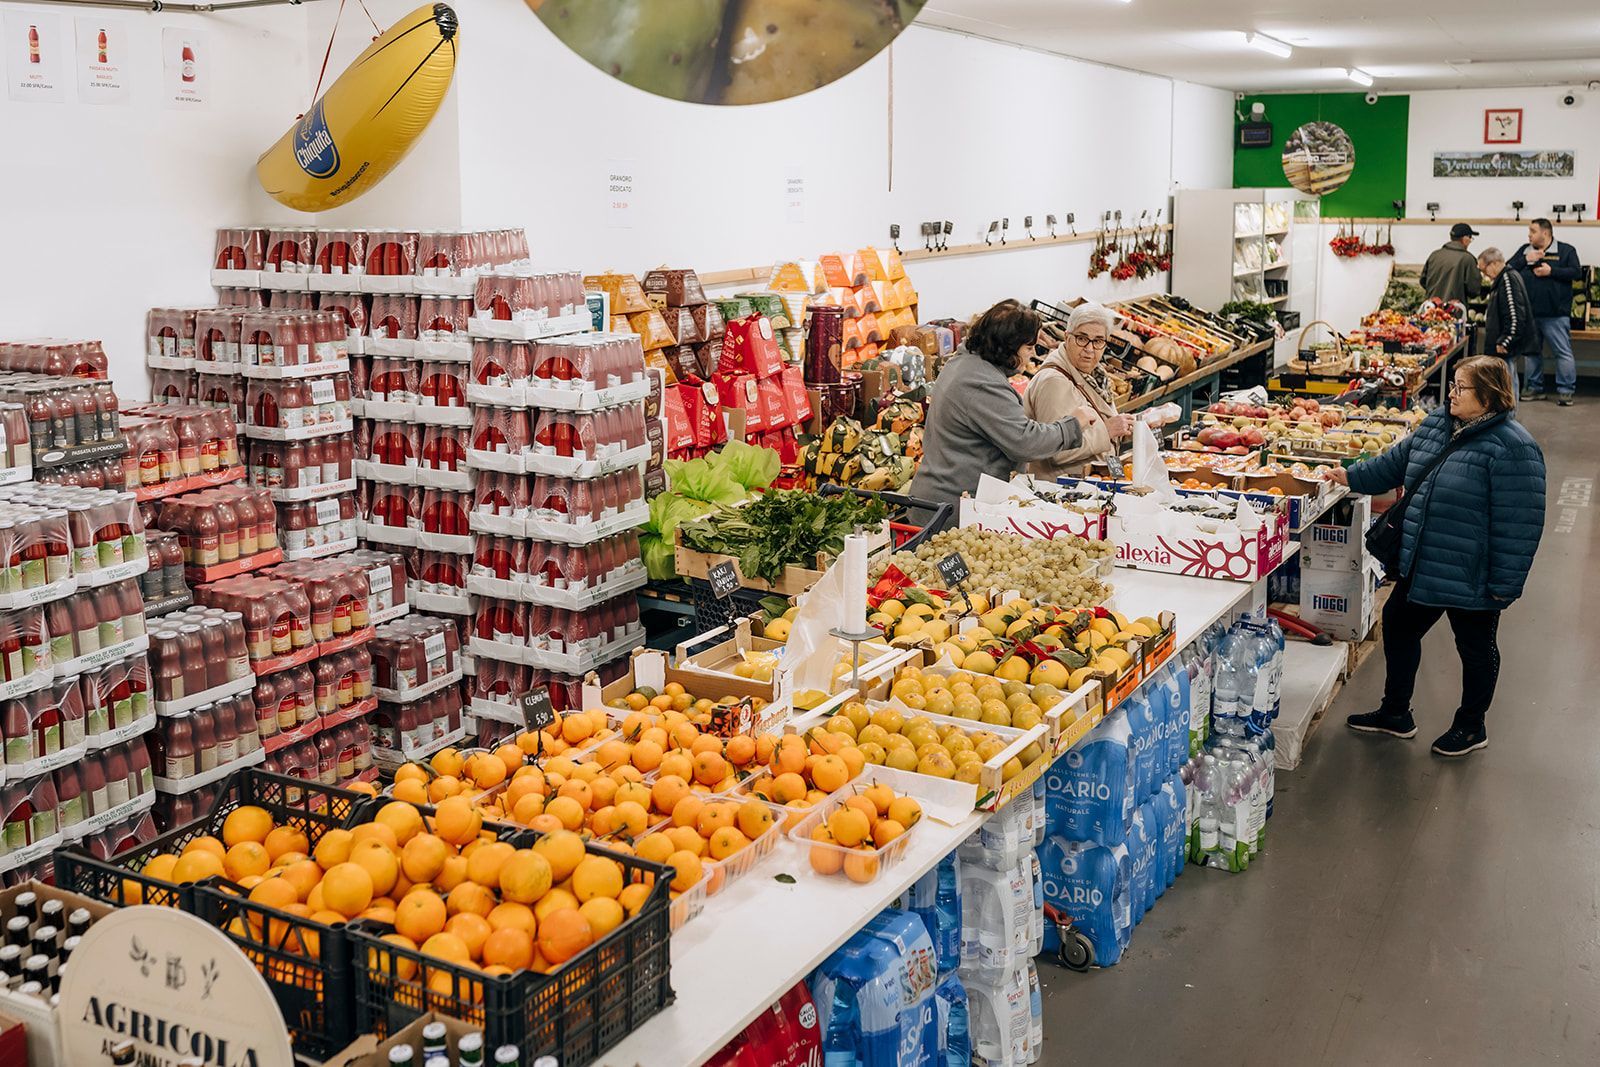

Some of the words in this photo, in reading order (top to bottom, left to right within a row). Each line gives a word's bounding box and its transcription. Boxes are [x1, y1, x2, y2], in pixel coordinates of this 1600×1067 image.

[296, 130, 332, 168] Chiquita
[1442, 159, 1490, 173] Verdure
[1516, 160, 1563, 172] Salento
[98, 443, 124, 452] POMODORO
[1313, 526, 1347, 544] FIUGGI
[1115, 542, 1171, 564] alexia
[712, 566, 727, 579] KAKI
[1313, 595, 1347, 613] FIUGGI
[81, 654, 102, 664] PASSATA
[108, 642, 134, 654] POMODORO
[1047, 776, 1110, 800] OARIO
[1056, 803, 1090, 815] NATURALE
[1044, 880, 1103, 906] OARIO
[83, 996, 264, 1067] AGRICOLA
